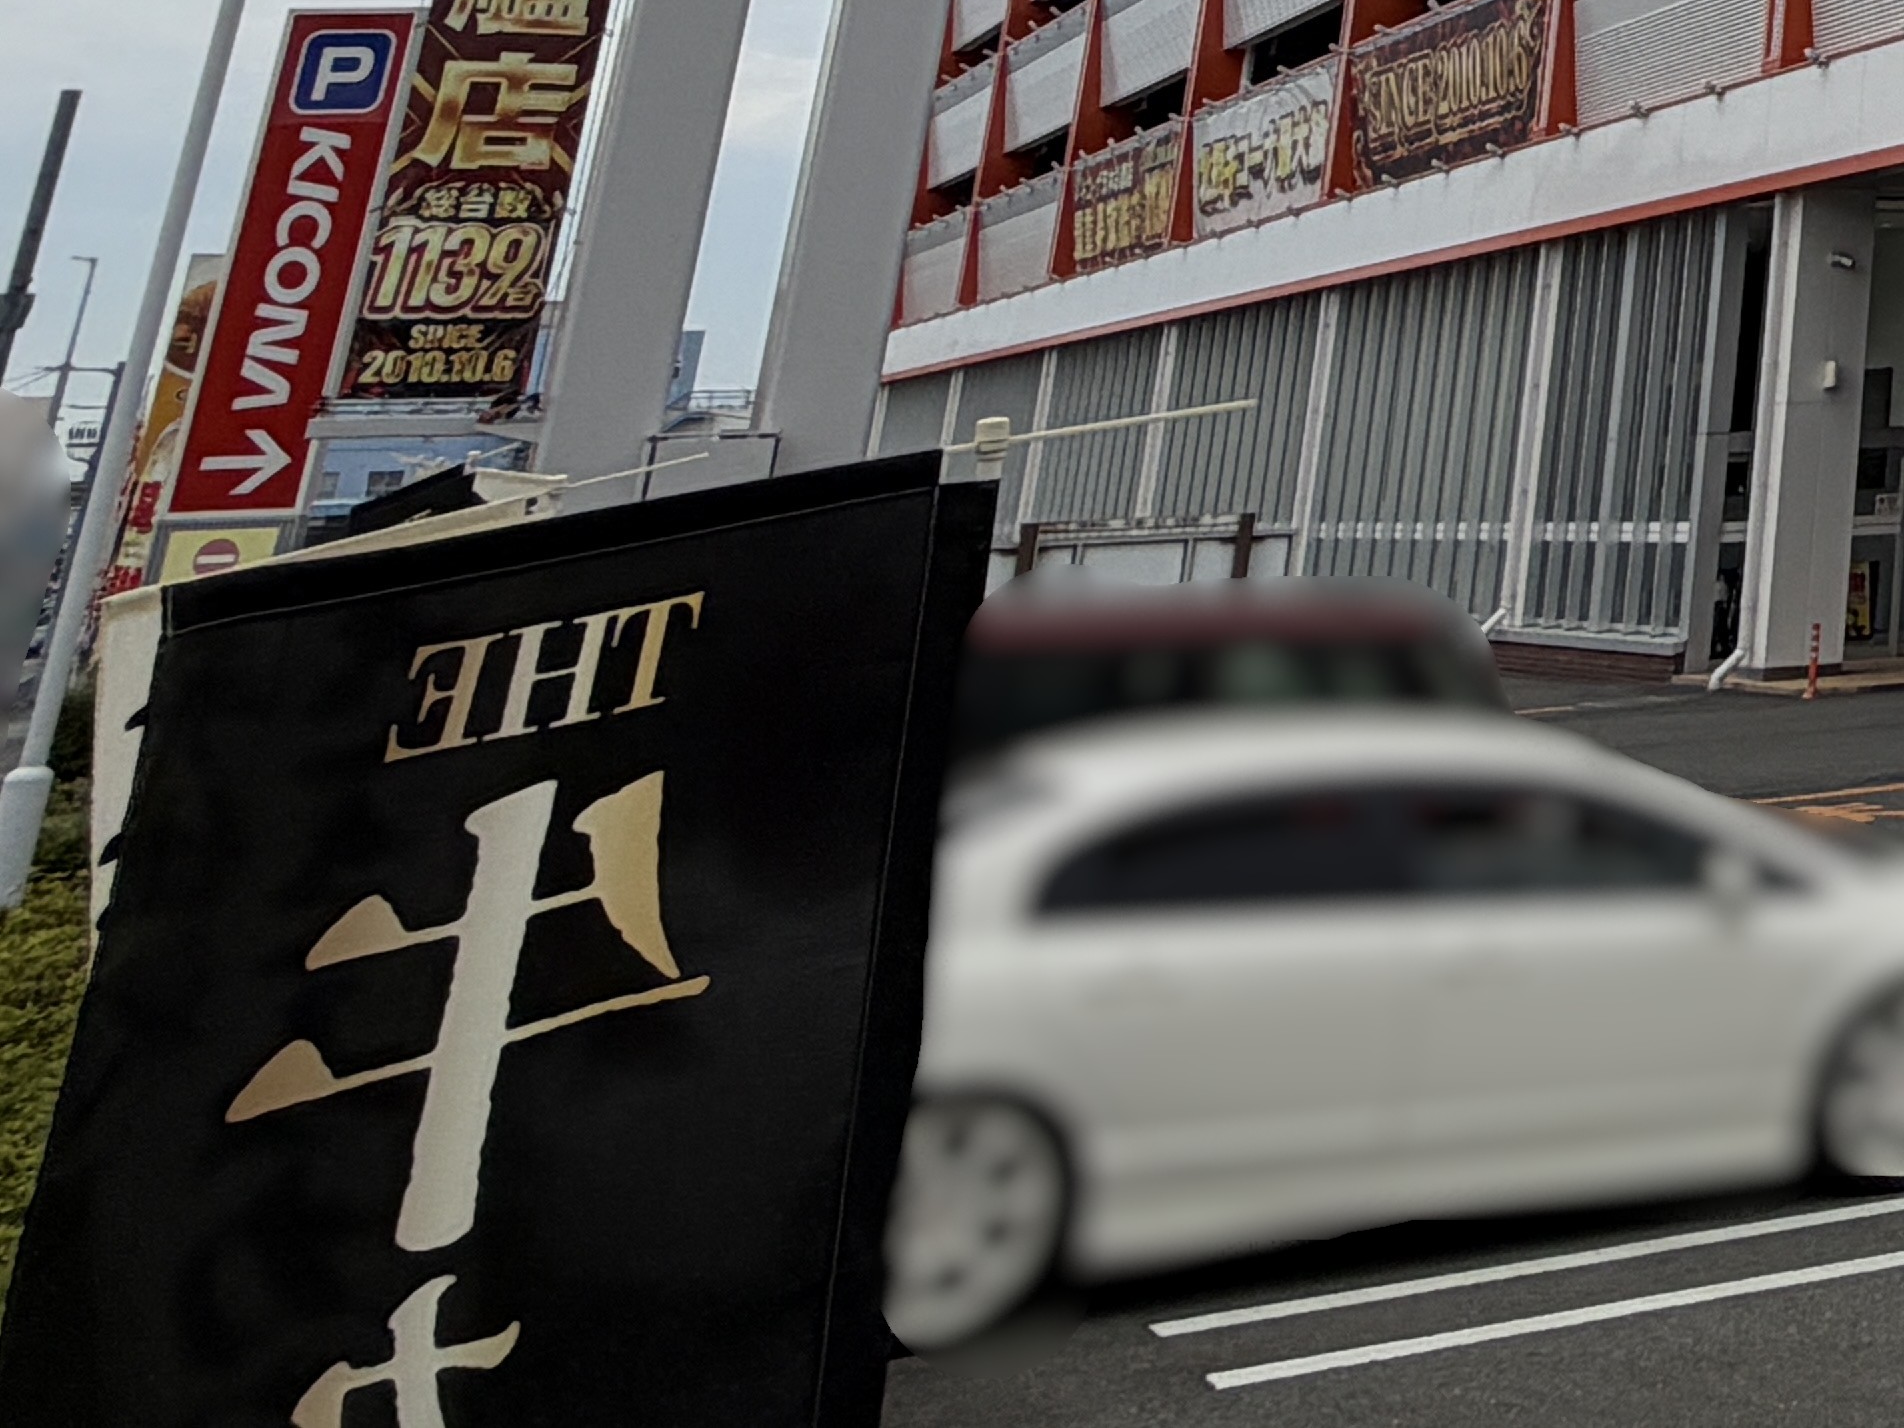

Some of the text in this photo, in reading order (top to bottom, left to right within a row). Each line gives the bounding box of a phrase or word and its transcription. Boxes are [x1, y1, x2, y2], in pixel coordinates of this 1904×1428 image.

[310, 46, 376, 102] P
[231, 126, 352, 411] KICONA
[357, 348, 518, 384] 2010.10.6
